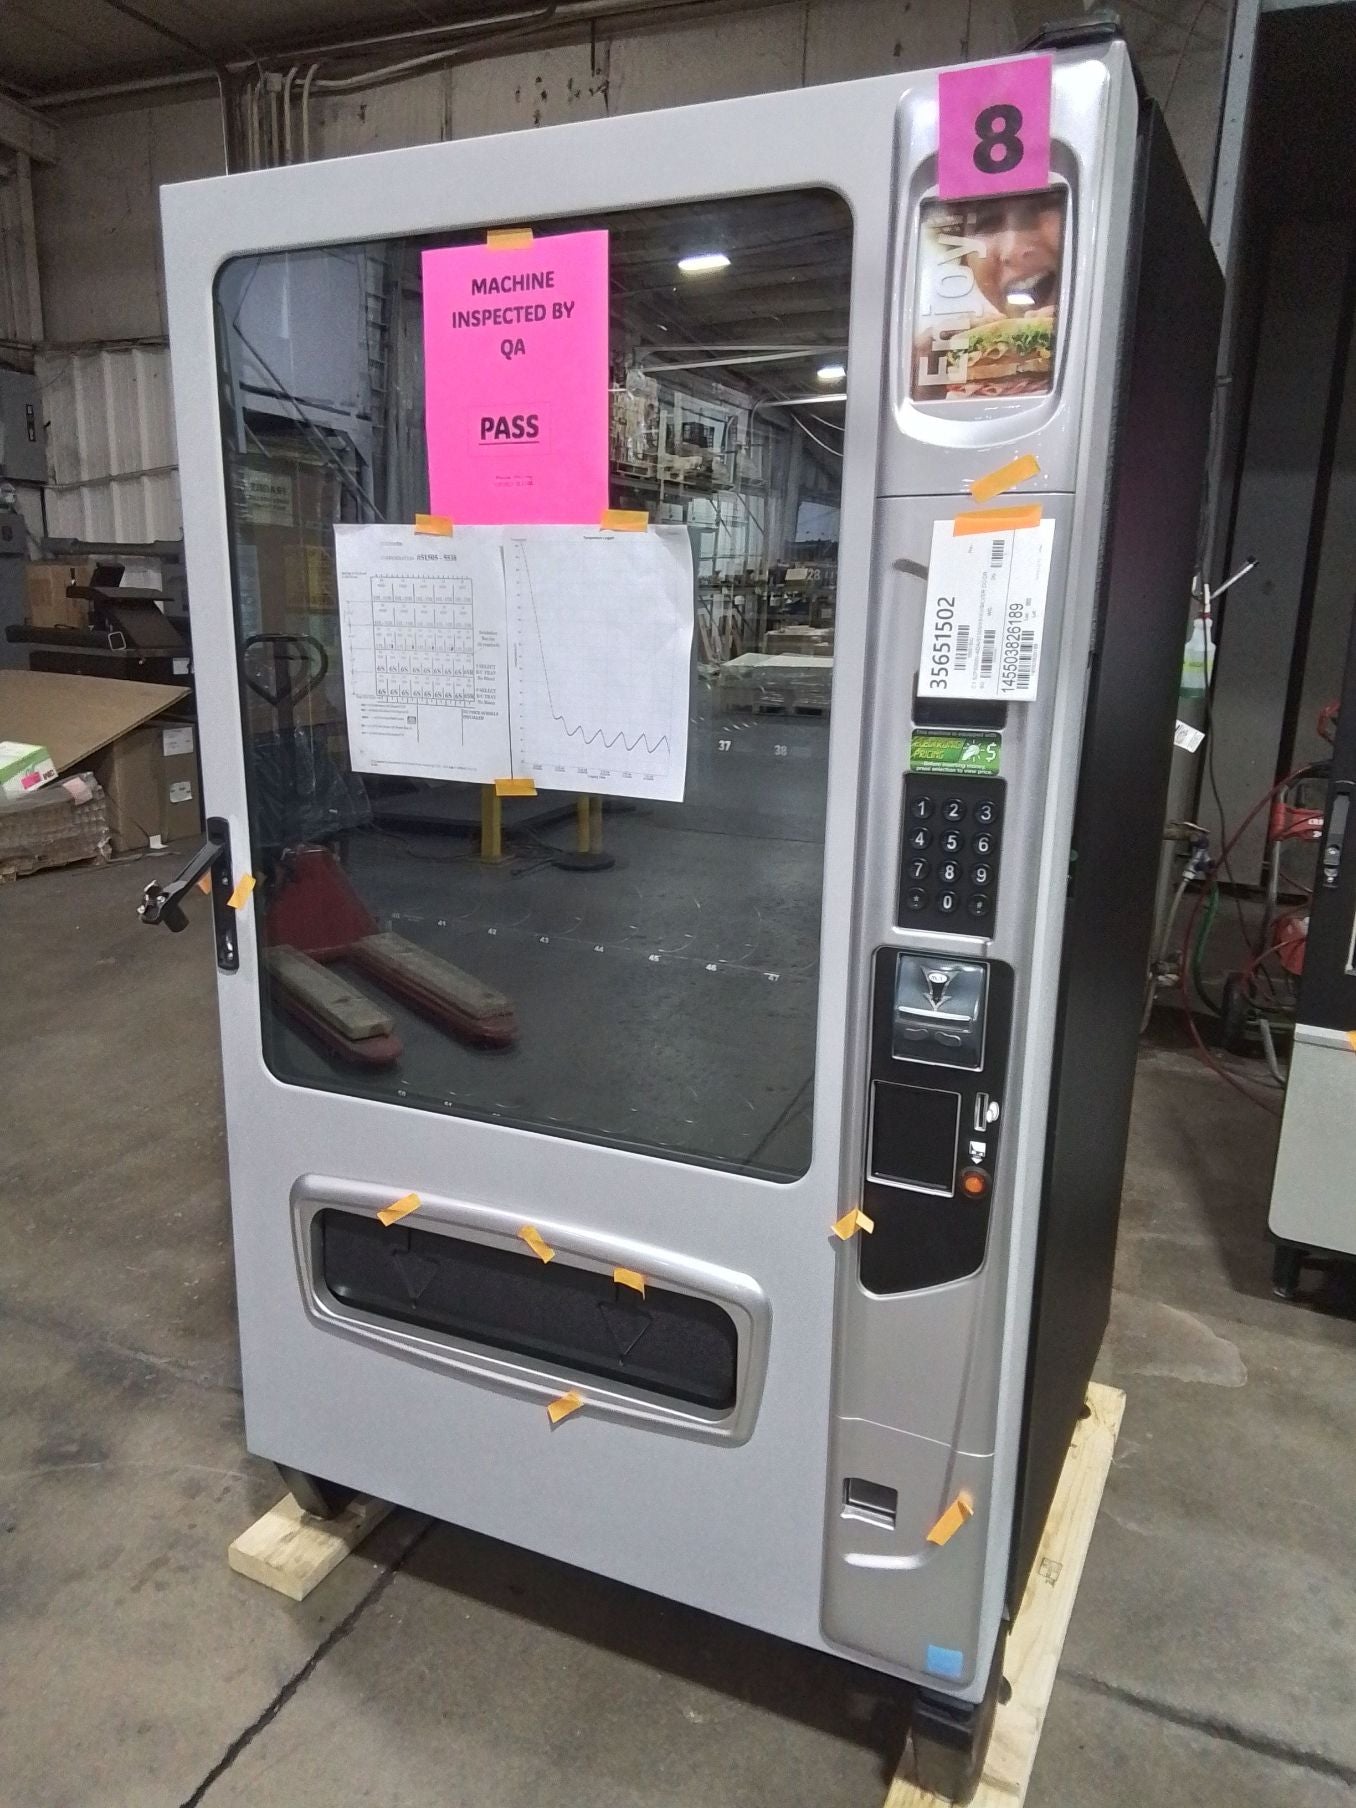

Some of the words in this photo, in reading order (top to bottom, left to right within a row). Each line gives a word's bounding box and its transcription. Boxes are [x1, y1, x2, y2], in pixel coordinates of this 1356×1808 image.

[973, 103, 1024, 174] 8
[471, 271, 555, 296] MACHINE
[452, 304, 546, 328] INSPECTED
[552, 301, 575, 320] BY
[500, 338, 526, 360] QA
[480, 414, 540, 440] PASS
[807, 568, 820, 581] 28
[930, 596, 956, 689] 35651502
[1001, 603, 1024, 693] 145503826189
[718, 740, 731, 751] 37
[774, 745, 787, 756] 38
[918, 802, 925, 815] 1
[949, 803, 959, 817] 2
[981, 806, 991, 820] 3
[915, 832, 924, 845] 4
[947, 835, 957, 850] 5
[978, 837, 989, 851] 6
[915, 863, 923, 876] 7
[945, 865, 954, 879] 8
[976, 868, 986, 882] 9
[943, 895, 952, 909] 0
